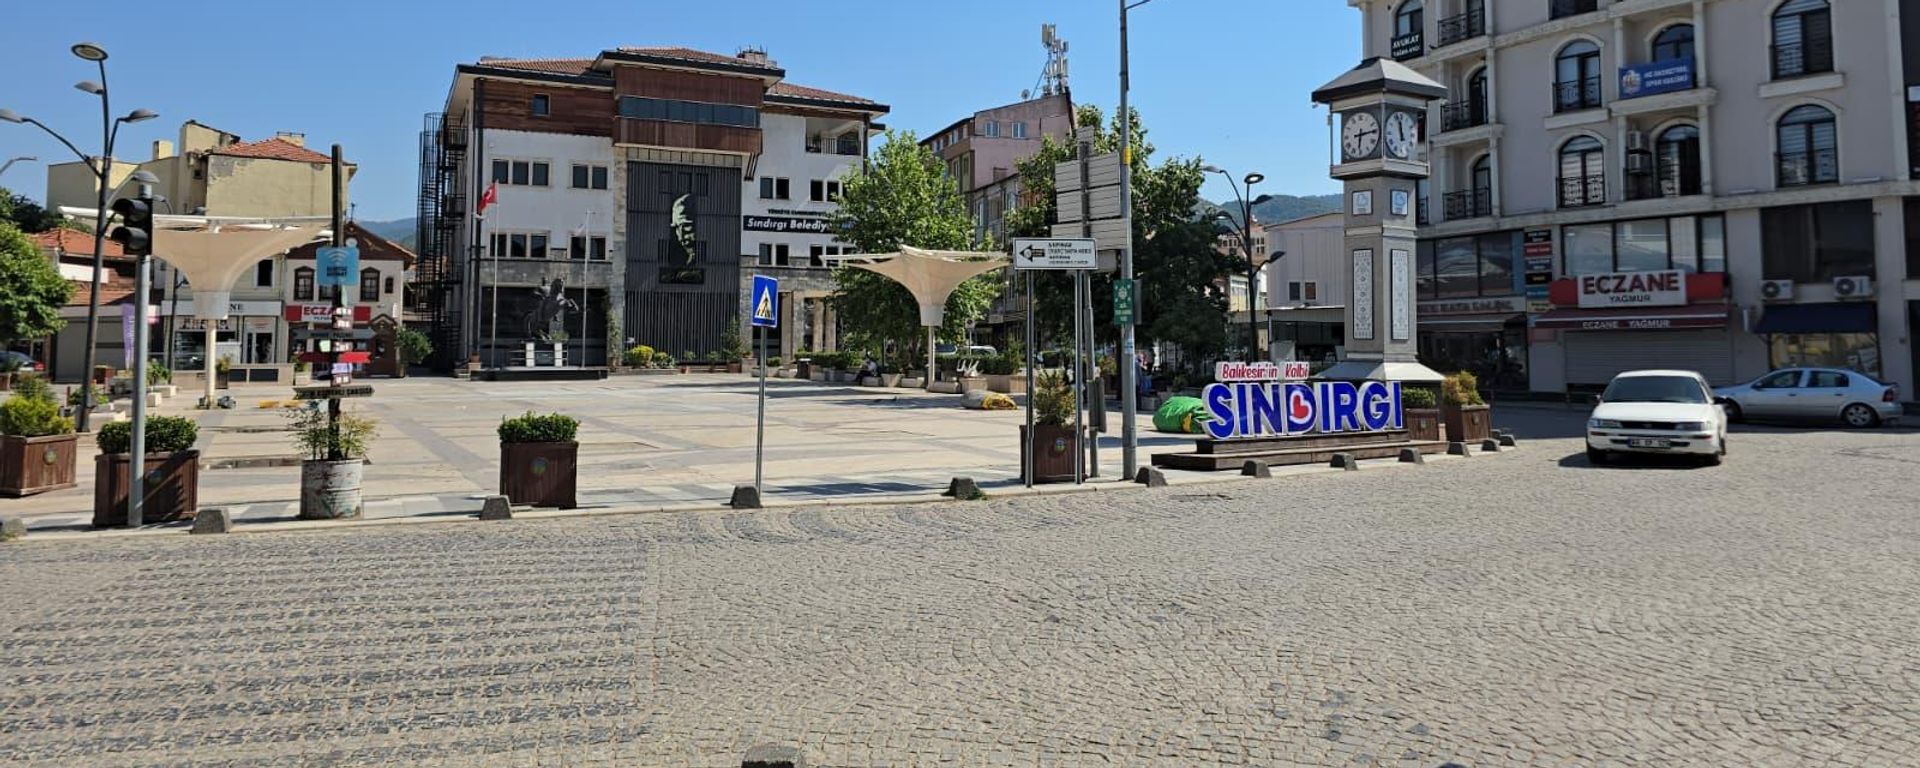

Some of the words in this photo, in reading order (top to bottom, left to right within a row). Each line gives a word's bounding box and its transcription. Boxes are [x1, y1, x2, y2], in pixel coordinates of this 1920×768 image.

[747, 218, 787, 231] Sındırgı
[790, 219, 832, 233] Belediy
[1583, 272, 1680, 295] ECZANE
[1582, 321, 1619, 329] ECZANE
[1285, 363, 1309, 378] Kalbi
[1204, 381, 1404, 440] SINDIRGI
